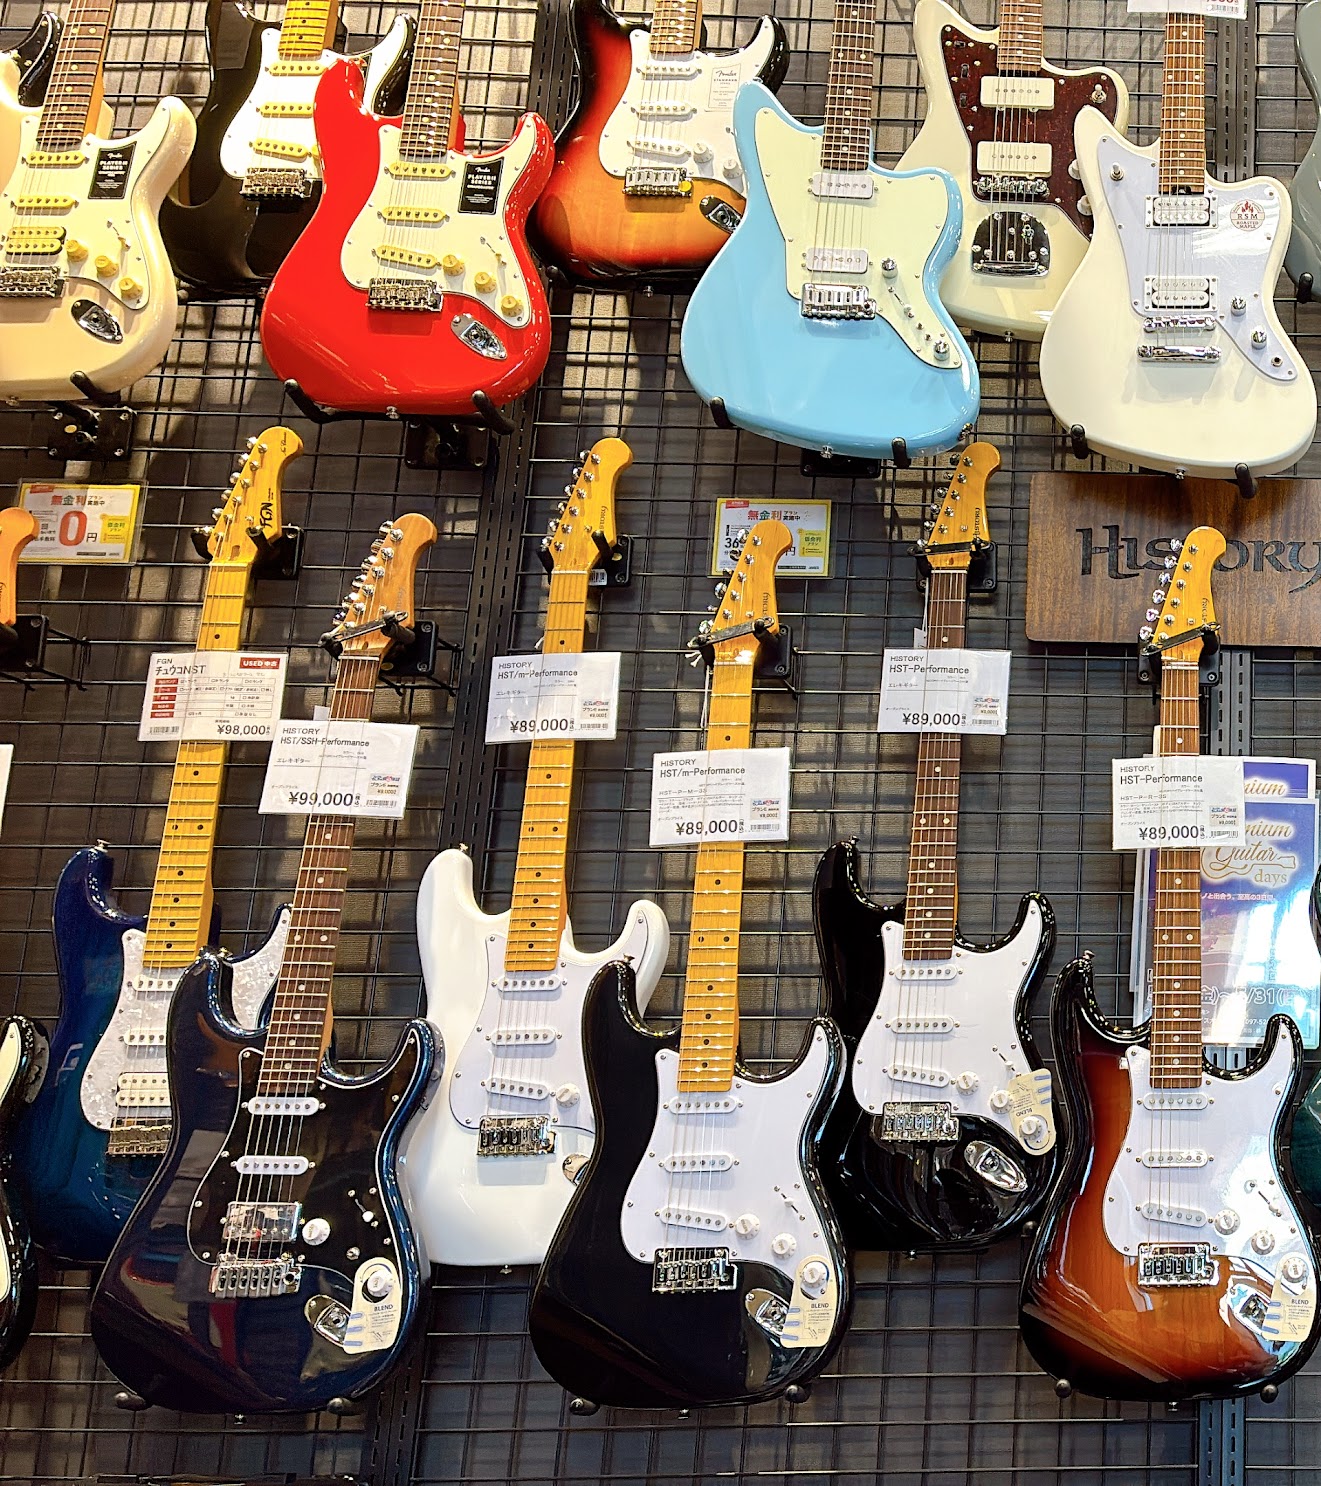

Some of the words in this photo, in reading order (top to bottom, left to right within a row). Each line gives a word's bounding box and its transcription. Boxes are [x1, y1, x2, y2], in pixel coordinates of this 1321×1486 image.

[51, 494, 87, 506] 無金利
[748, 510, 782, 521] 無金利
[59, 510, 87, 546] 0
[498, 661, 533, 669] HISTORY
[889, 664, 970, 675] HST-Performance
[509, 718, 568, 733] ¥89,000
[902, 712, 960, 727] ¥89,000
[217, 724, 266, 736] ¥98,000
[282, 727, 321, 735] HISTORY
[280, 736, 370, 747] HST/SSH-Performance
[660, 758, 697, 767] HISTORY
[660, 767, 746, 778] HST/m-Performance
[1120, 765, 1155, 773] HISTORY
[1120, 773, 1203, 785] HST-Performance
[288, 791, 354, 808] ¥99,000
[675, 819, 738, 836] ¥89,000
[1139, 825, 1199, 841] ¥89,000
[1254, 868, 1288, 887] days
[373, 1303, 394, 1312] BLEND
